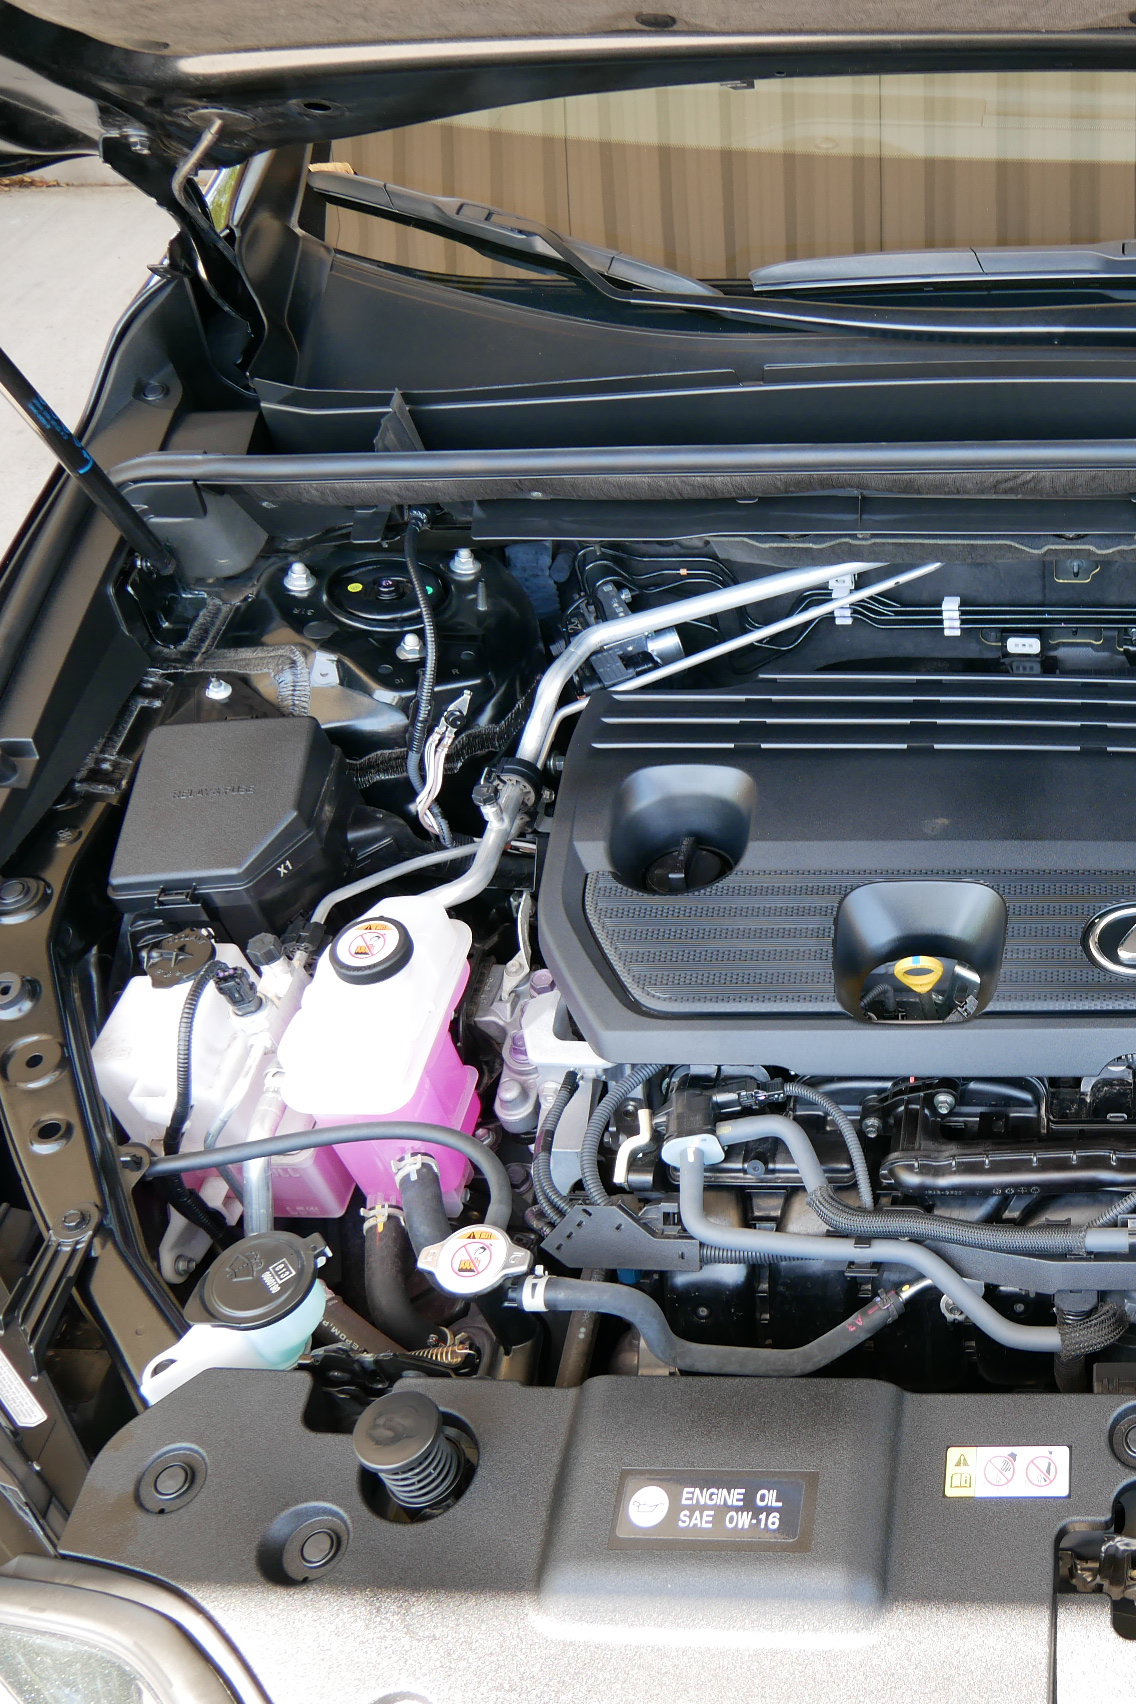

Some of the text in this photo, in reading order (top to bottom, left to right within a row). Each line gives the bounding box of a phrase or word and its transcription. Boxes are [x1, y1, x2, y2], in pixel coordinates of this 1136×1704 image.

[681, 1487, 783, 1508] ENGINE OIL
[678, 1510, 781, 1530] SAE 0W-16
